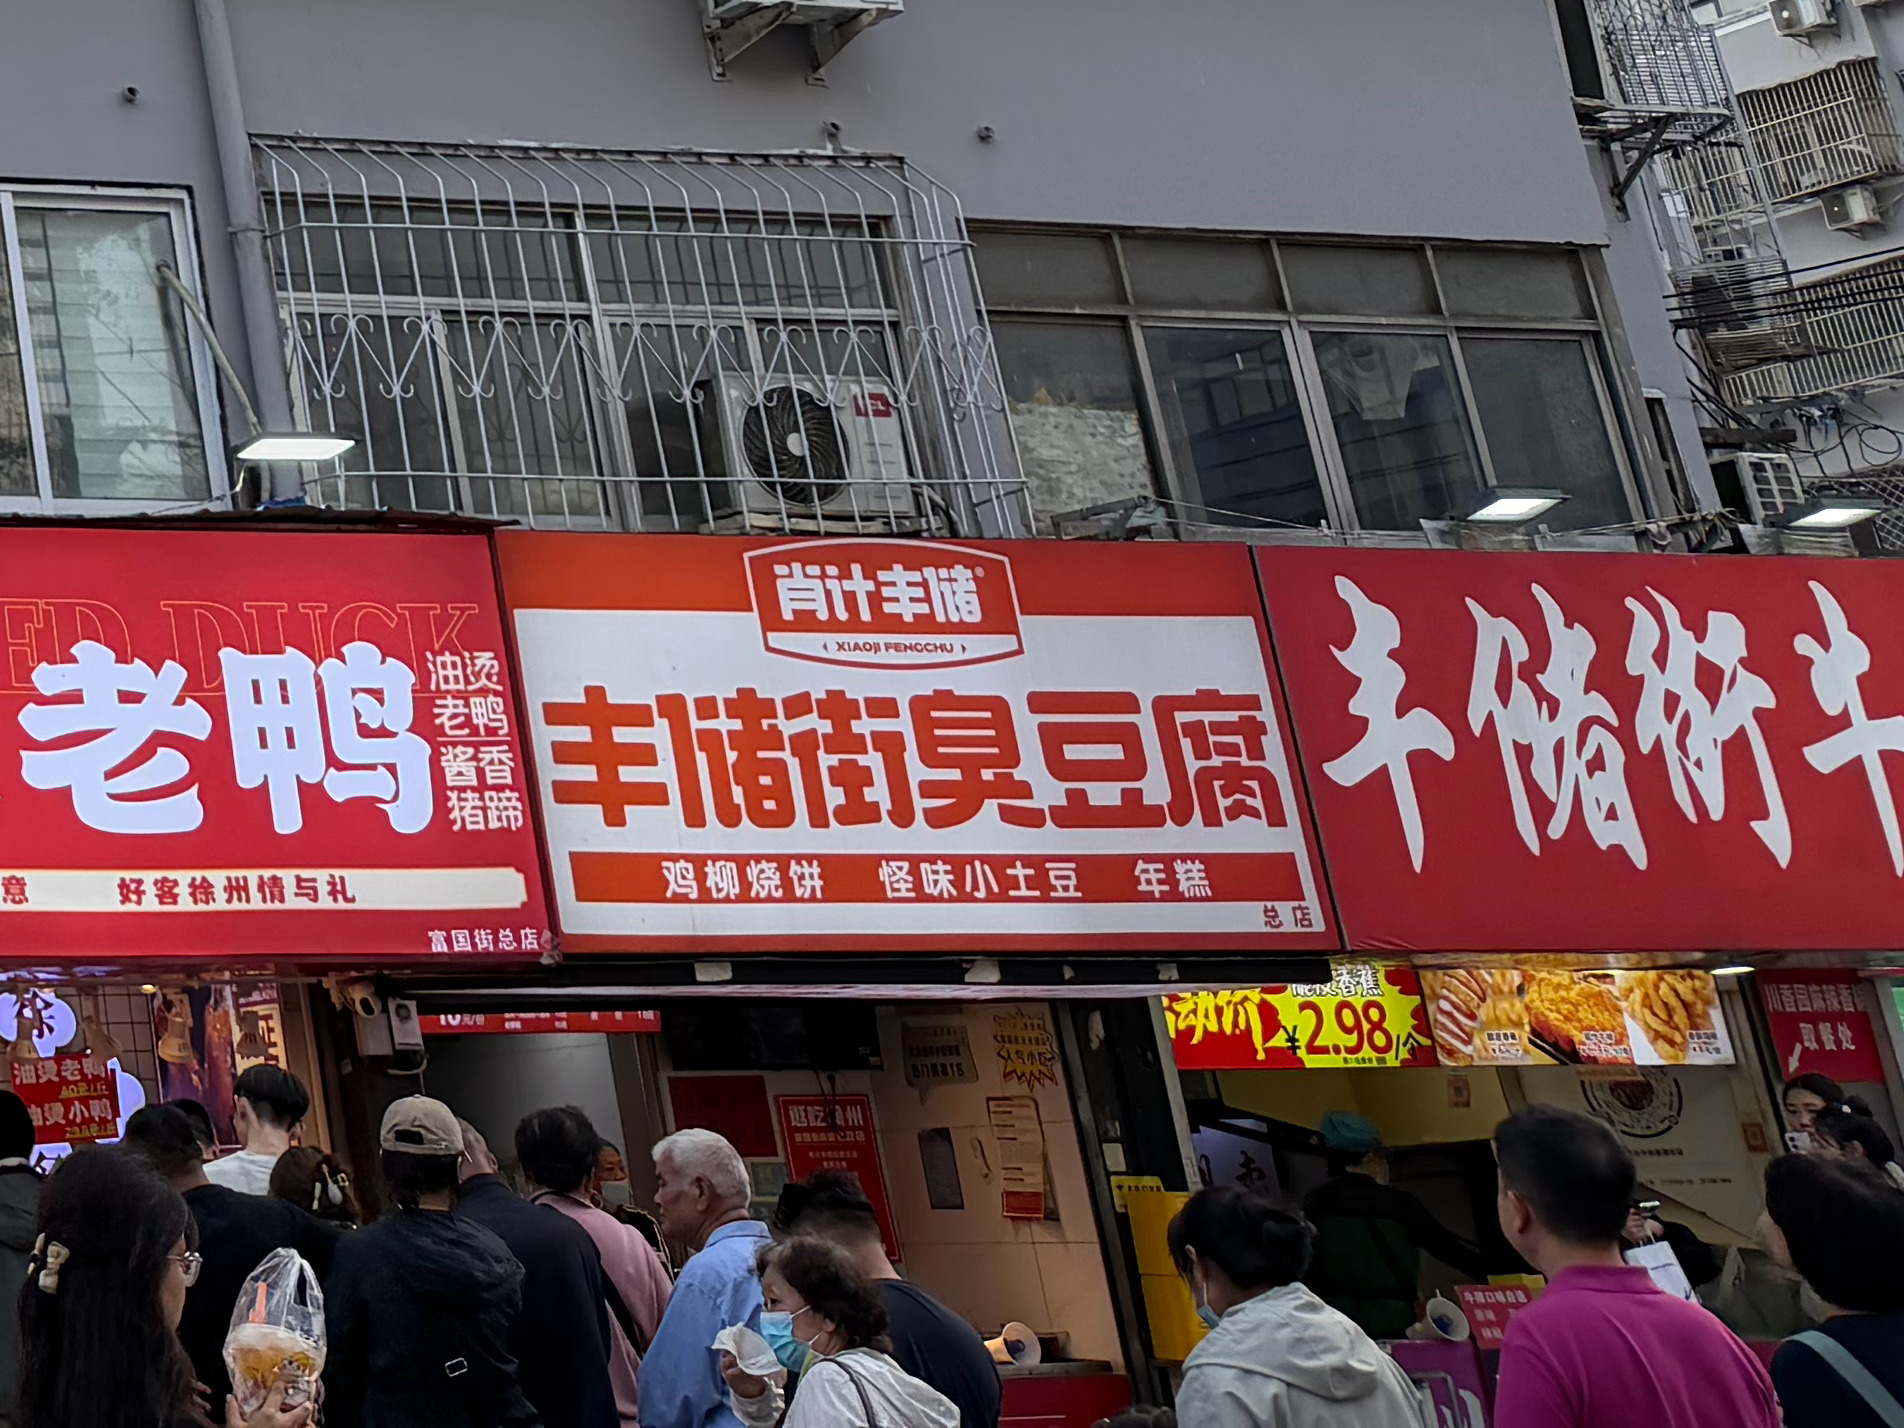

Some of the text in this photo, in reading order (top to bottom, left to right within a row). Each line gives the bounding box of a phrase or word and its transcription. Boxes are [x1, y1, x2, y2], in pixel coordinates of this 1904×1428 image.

[773, 562, 982, 623] 肖计丰储
[884, 641, 954, 654] FENGCHU
[426, 651, 503, 692] 油烫
[433, 694, 509, 737] 老鸭
[1322, 575, 1904, 877] 丰储街牛
[440, 744, 514, 788] 酱香
[542, 685, 1287, 830] 丰储街臭豆腐
[448, 788, 523, 832] 猪蹄
[118, 875, 357, 907] 好客徐州情与礼
[661, 858, 1212, 899] 鸡柳烧饼 怪味小土豆 年糕
[1263, 904, 1314, 930] 总店
[428, 927, 539, 953] 富国街总店
[1161, 989, 1267, 1061] 动价
[13, 1059, 106, 1086] 油烫老鸭
